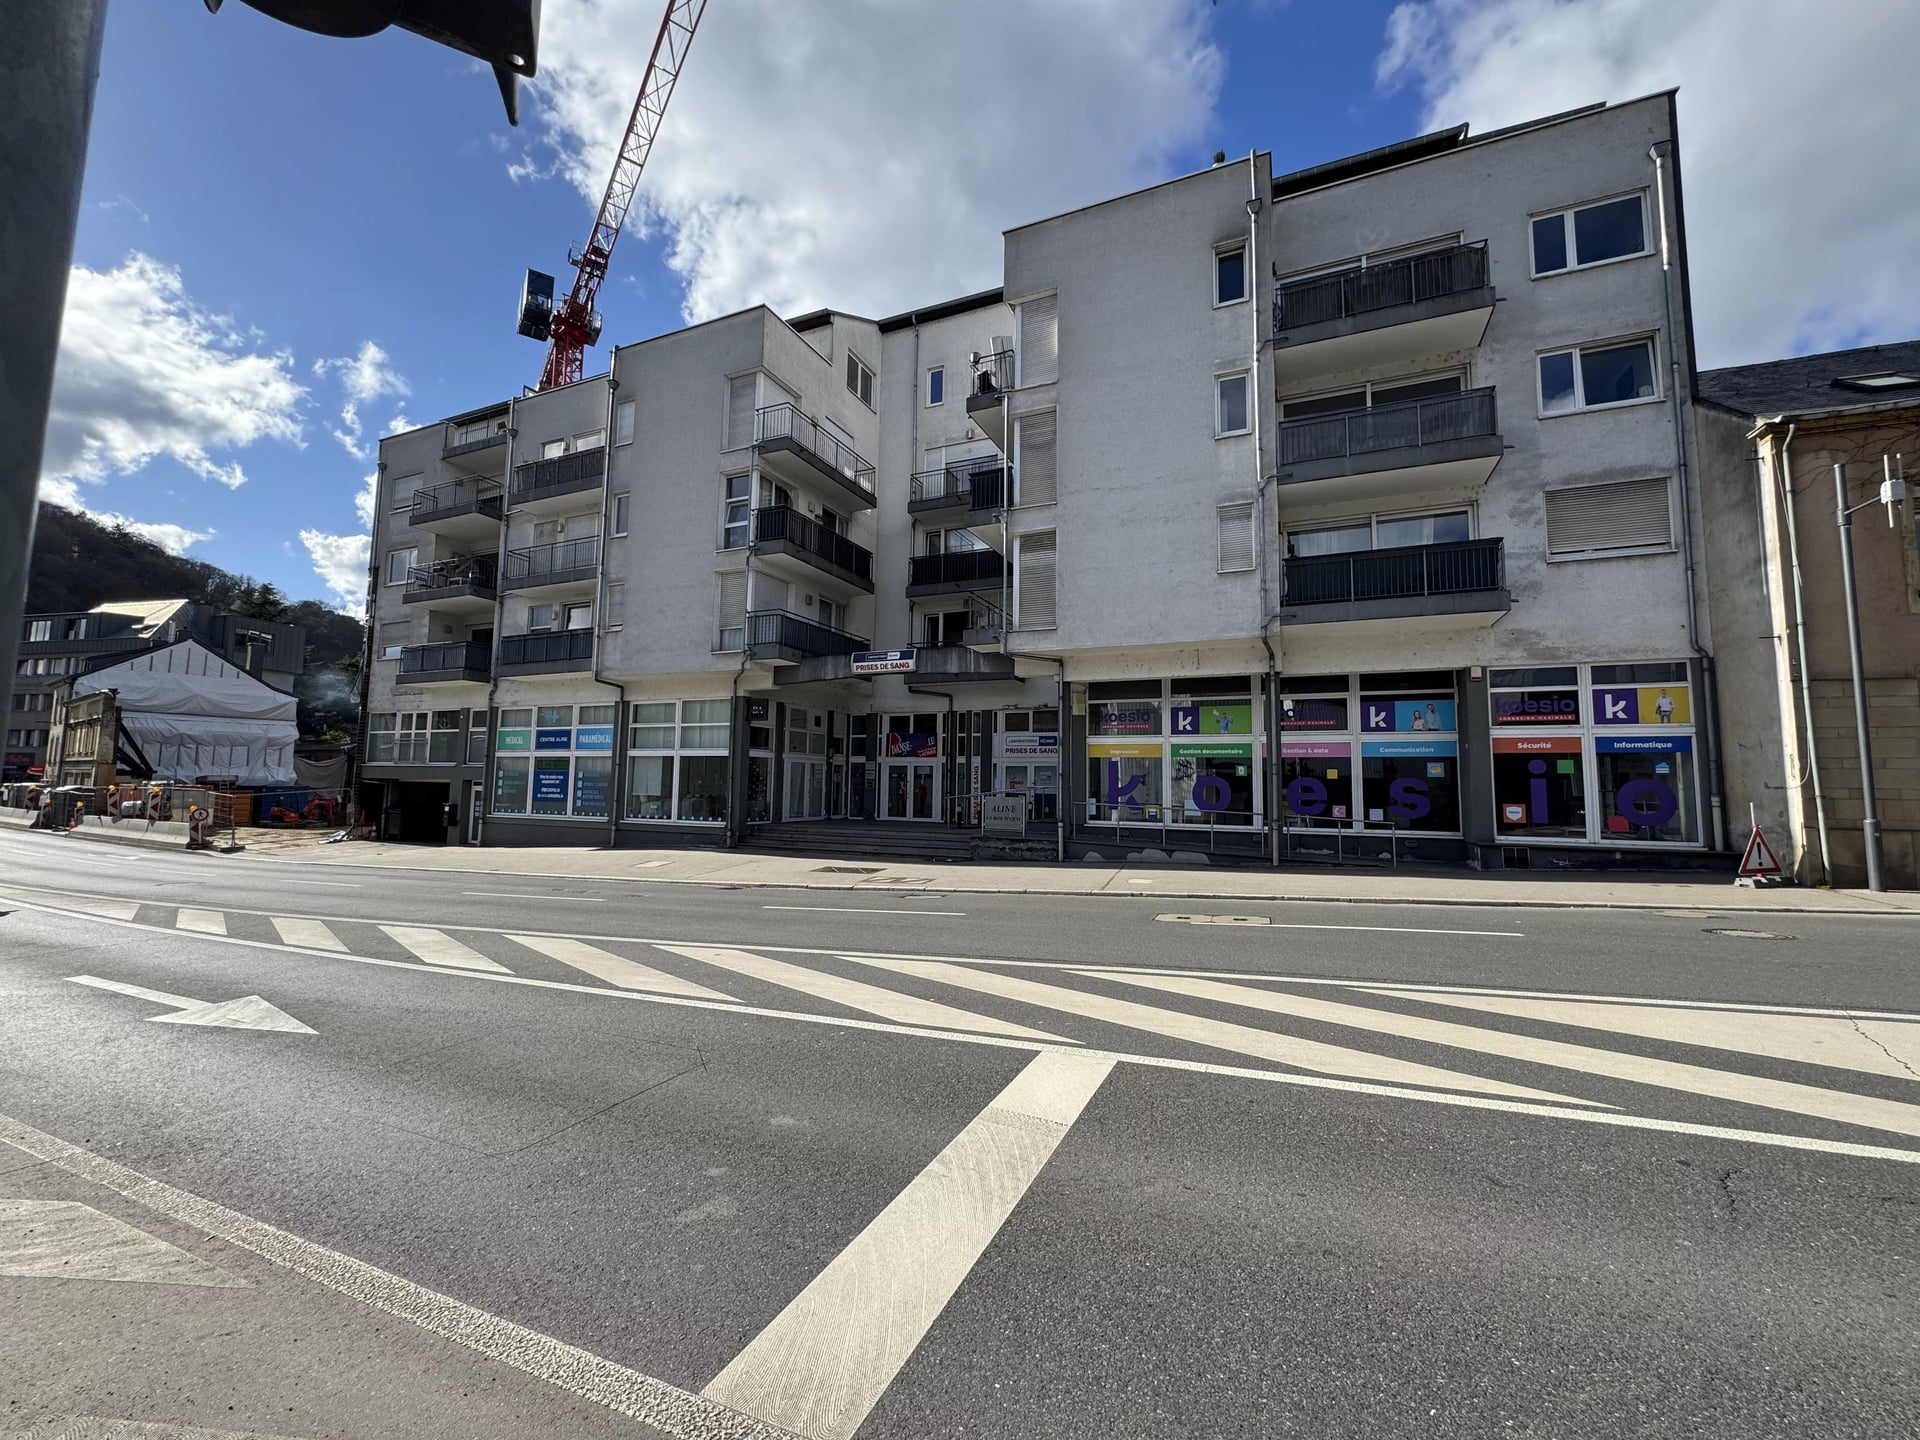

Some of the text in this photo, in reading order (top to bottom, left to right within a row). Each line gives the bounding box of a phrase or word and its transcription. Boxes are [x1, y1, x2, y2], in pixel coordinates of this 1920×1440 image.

[1494, 695, 1575, 713] koesio
[1100, 709, 1151, 722] koesio
[505, 735, 524, 745] MÉDICAL
[579, 732, 611, 744] PARAMÉDICAL
[1517, 741, 1552, 749] Sécurité
[1613, 741, 1673, 750] Informatique
[991, 805, 1017, 813] ALINE
